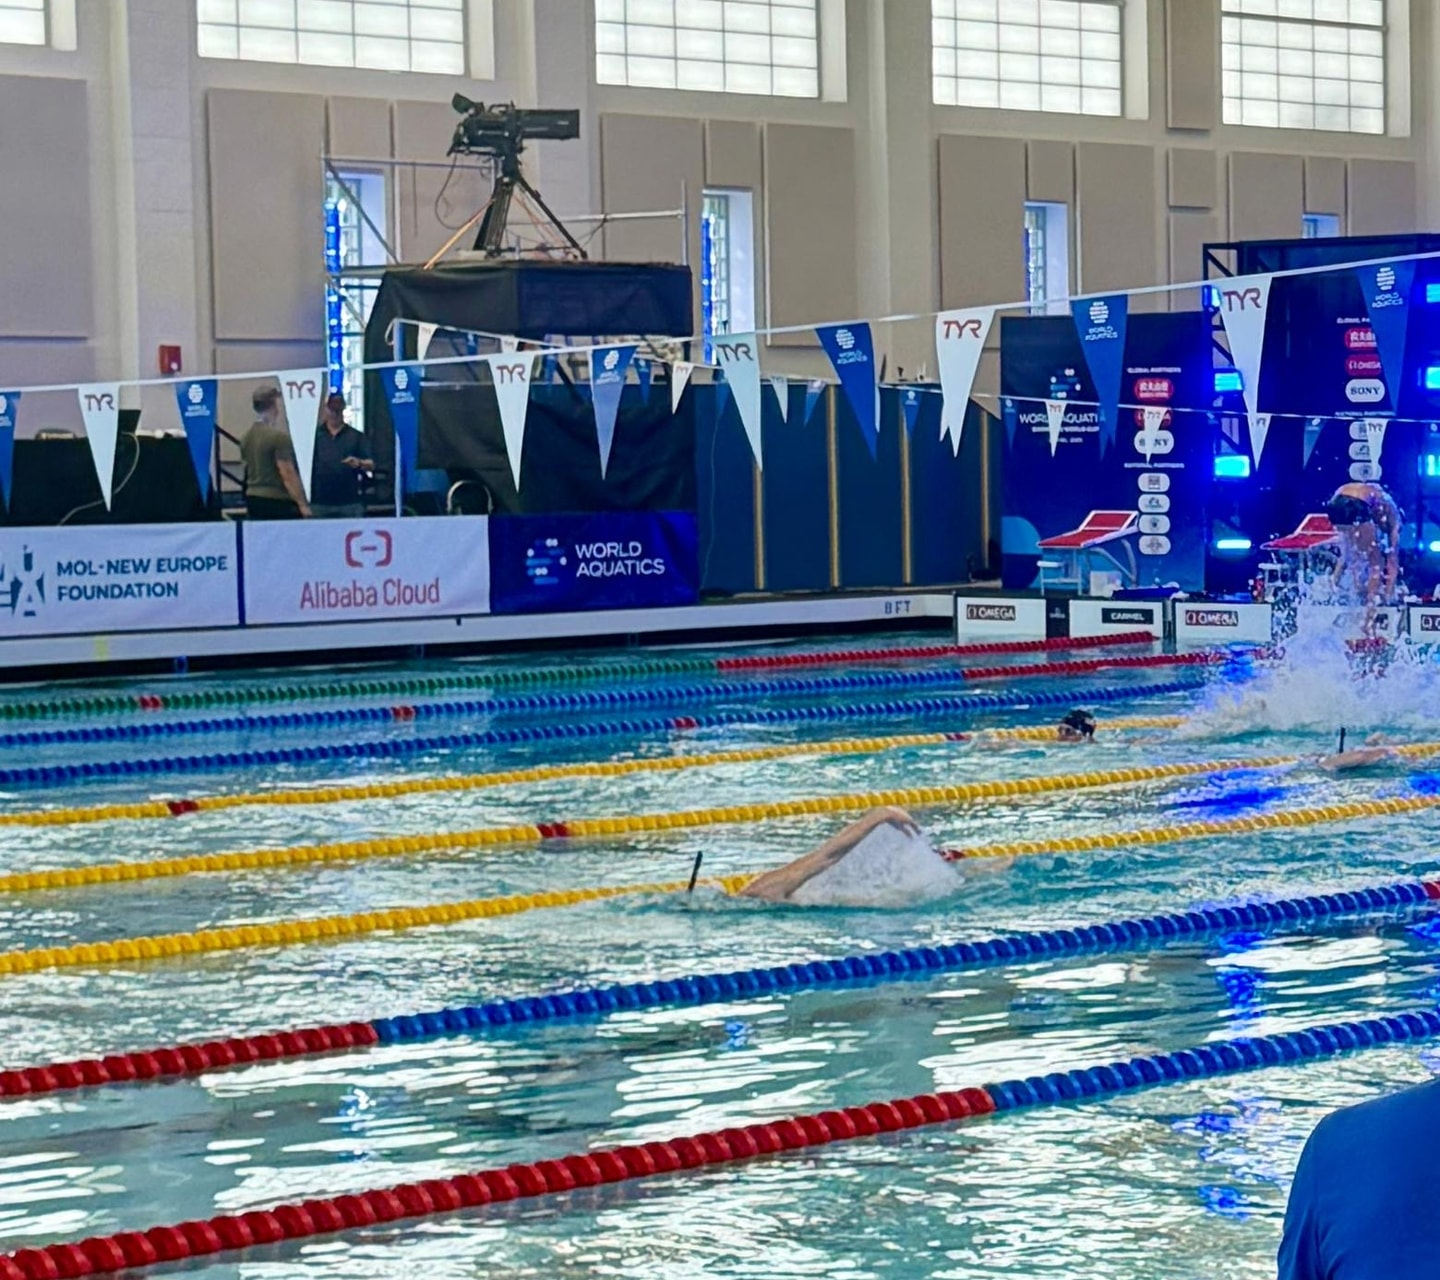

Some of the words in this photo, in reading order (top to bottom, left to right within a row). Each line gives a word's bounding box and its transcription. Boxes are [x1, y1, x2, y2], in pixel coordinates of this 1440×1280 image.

[1222, 288, 1262, 312] TYR
[943, 320, 982, 339] TYR
[1088, 326, 1113, 334] WORLD
[717, 343, 754, 362] TYR
[496, 363, 526, 385] TYR
[286, 380, 316, 400] TYR
[1350, 387, 1379, 396] SONY
[84, 394, 115, 412] TYR
[1020, 413, 1047, 424] WORL
[1138, 439, 1169, 447] SNY
[575, 541, 642, 559] WORLD
[156, 556, 228, 572] EUROPE
[576, 558, 665, 578] AQUATICS
[58, 582, 179, 602] FOUNDATION
[301, 580, 377, 609] Alibaba
[383, 577, 440, 605] Cloud
[979, 606, 1015, 619] OMEGA
[1110, 611, 1145, 621] CARMEL
[1200, 611, 1238, 625] OMEGA
